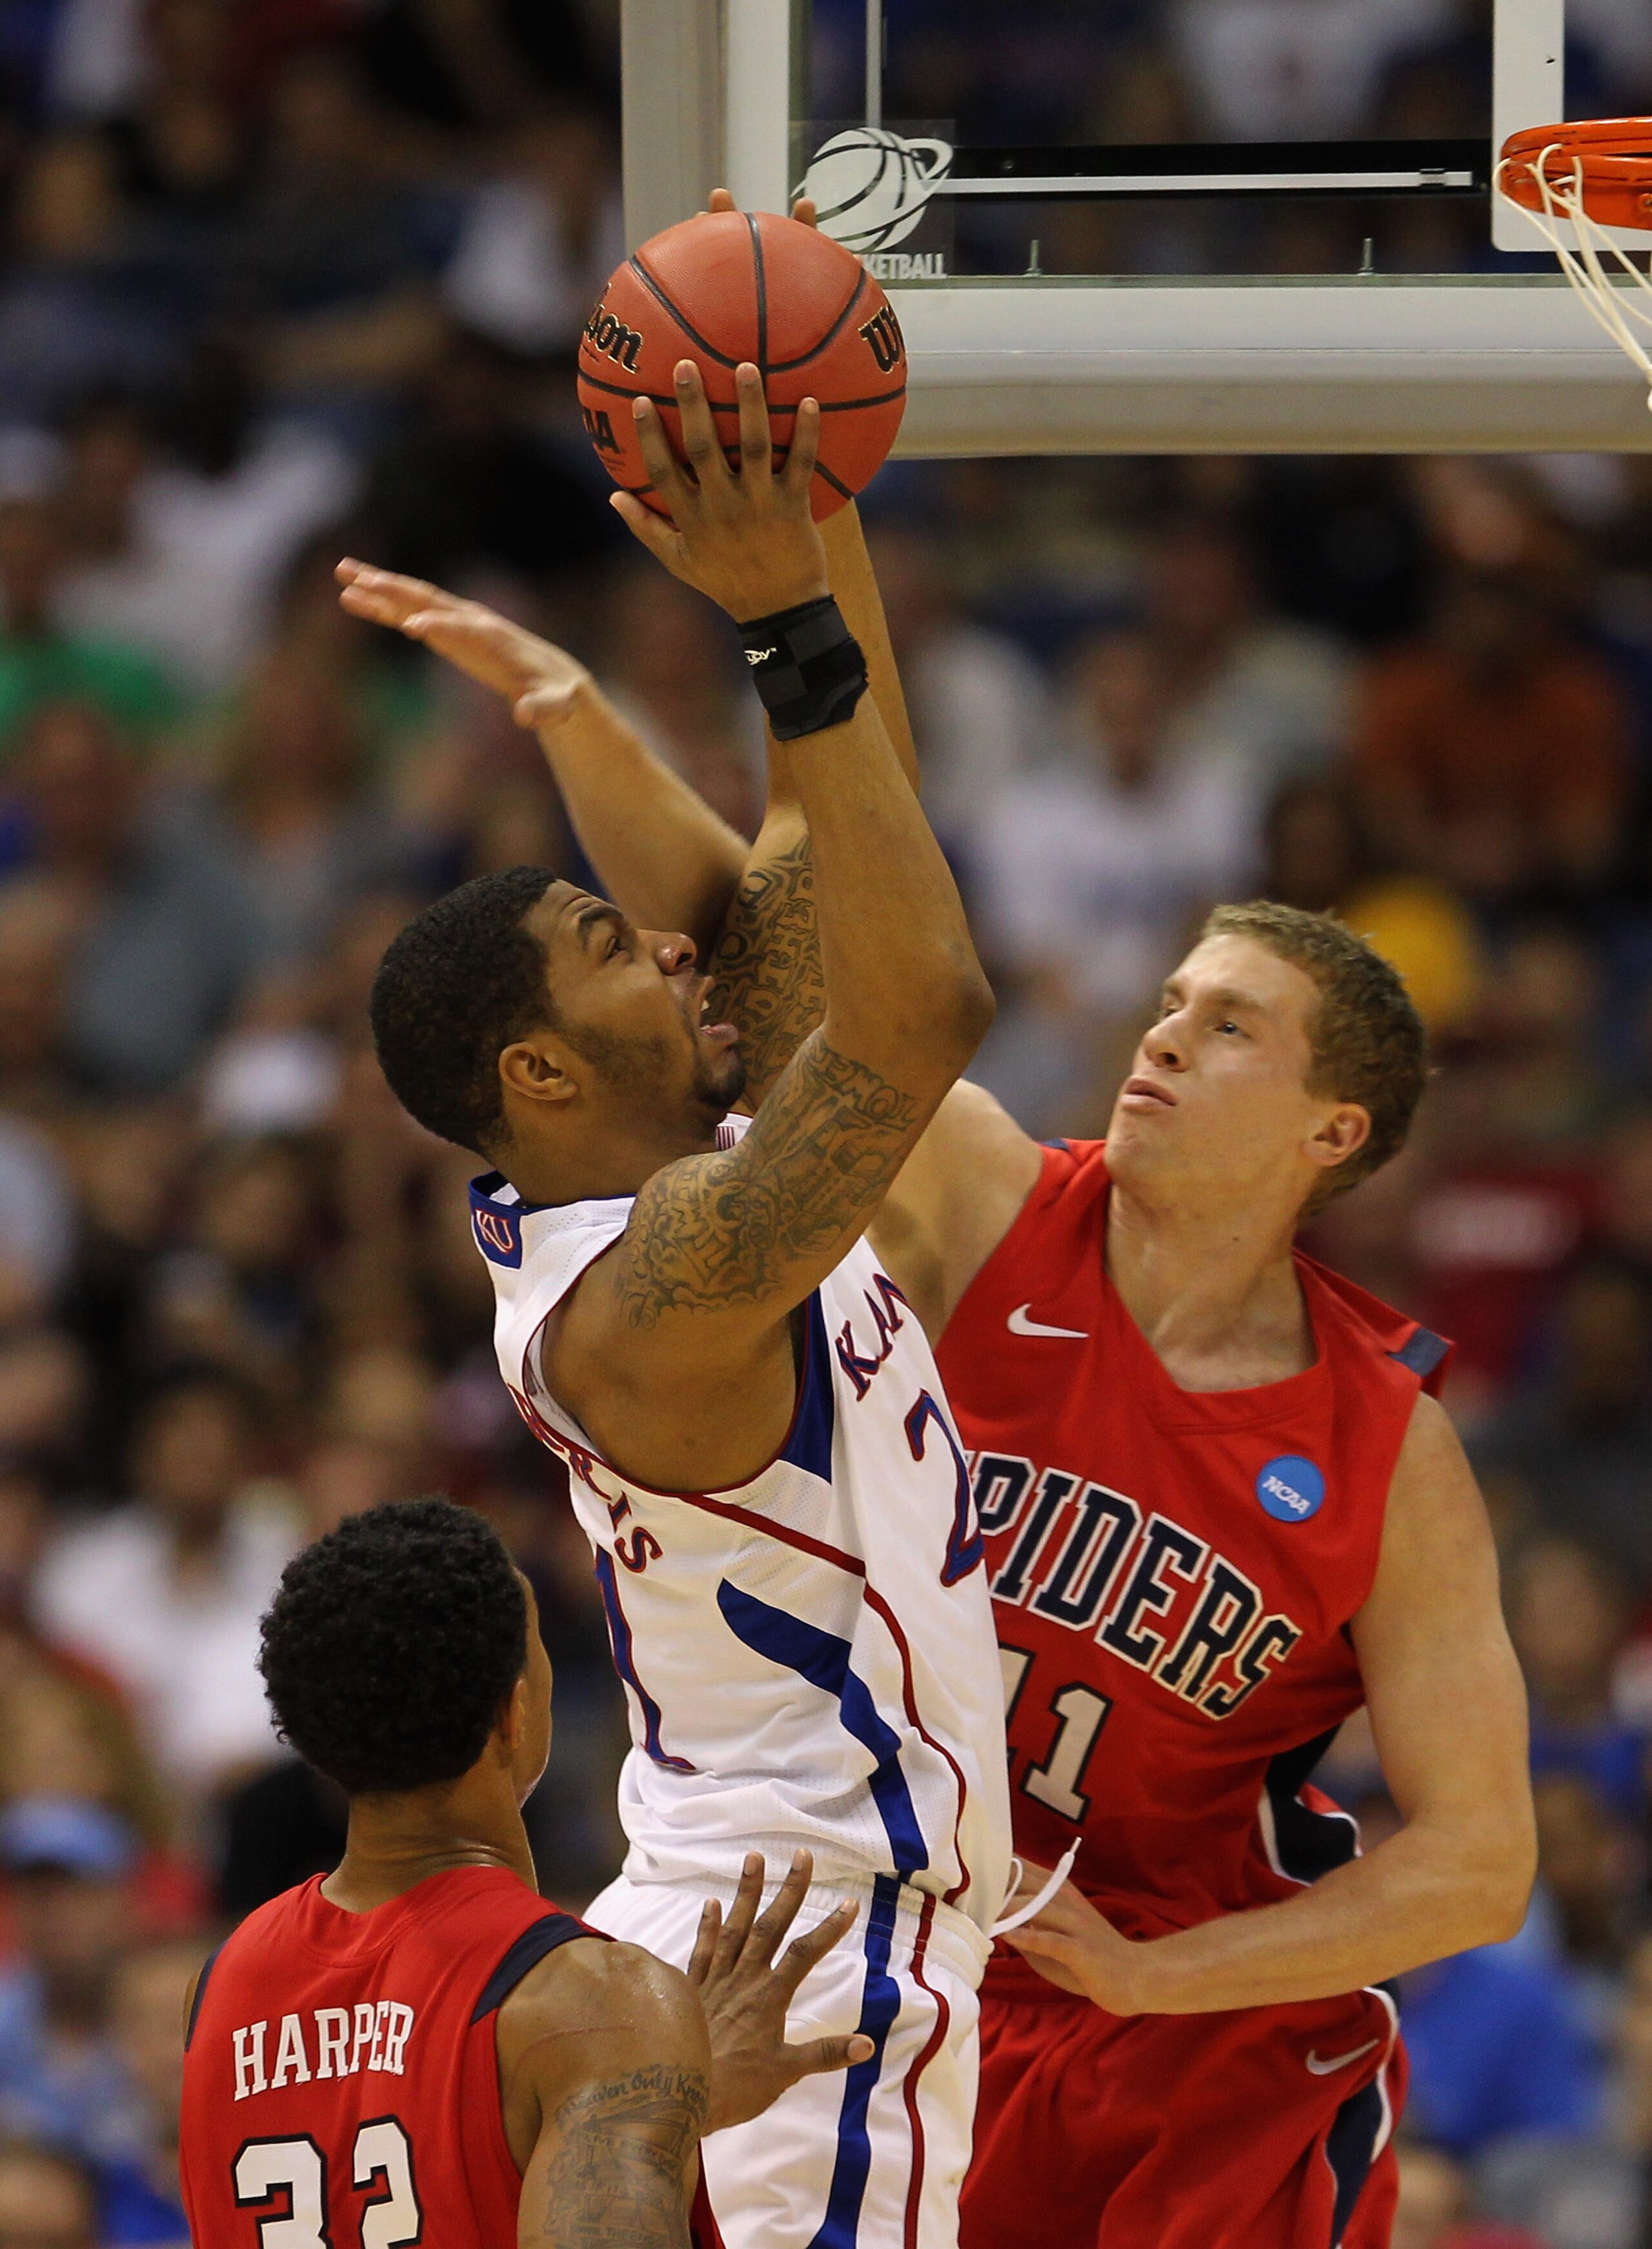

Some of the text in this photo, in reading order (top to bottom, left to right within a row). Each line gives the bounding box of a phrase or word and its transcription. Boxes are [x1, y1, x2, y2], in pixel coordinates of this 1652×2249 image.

[475, 1208, 514, 1255] KU
[1262, 1475, 1311, 1514] NCAA
[963, 1449, 1303, 1720] PIDERS
[232, 1999, 414, 2102] HARPER
[230, 2113, 423, 2249] 32
